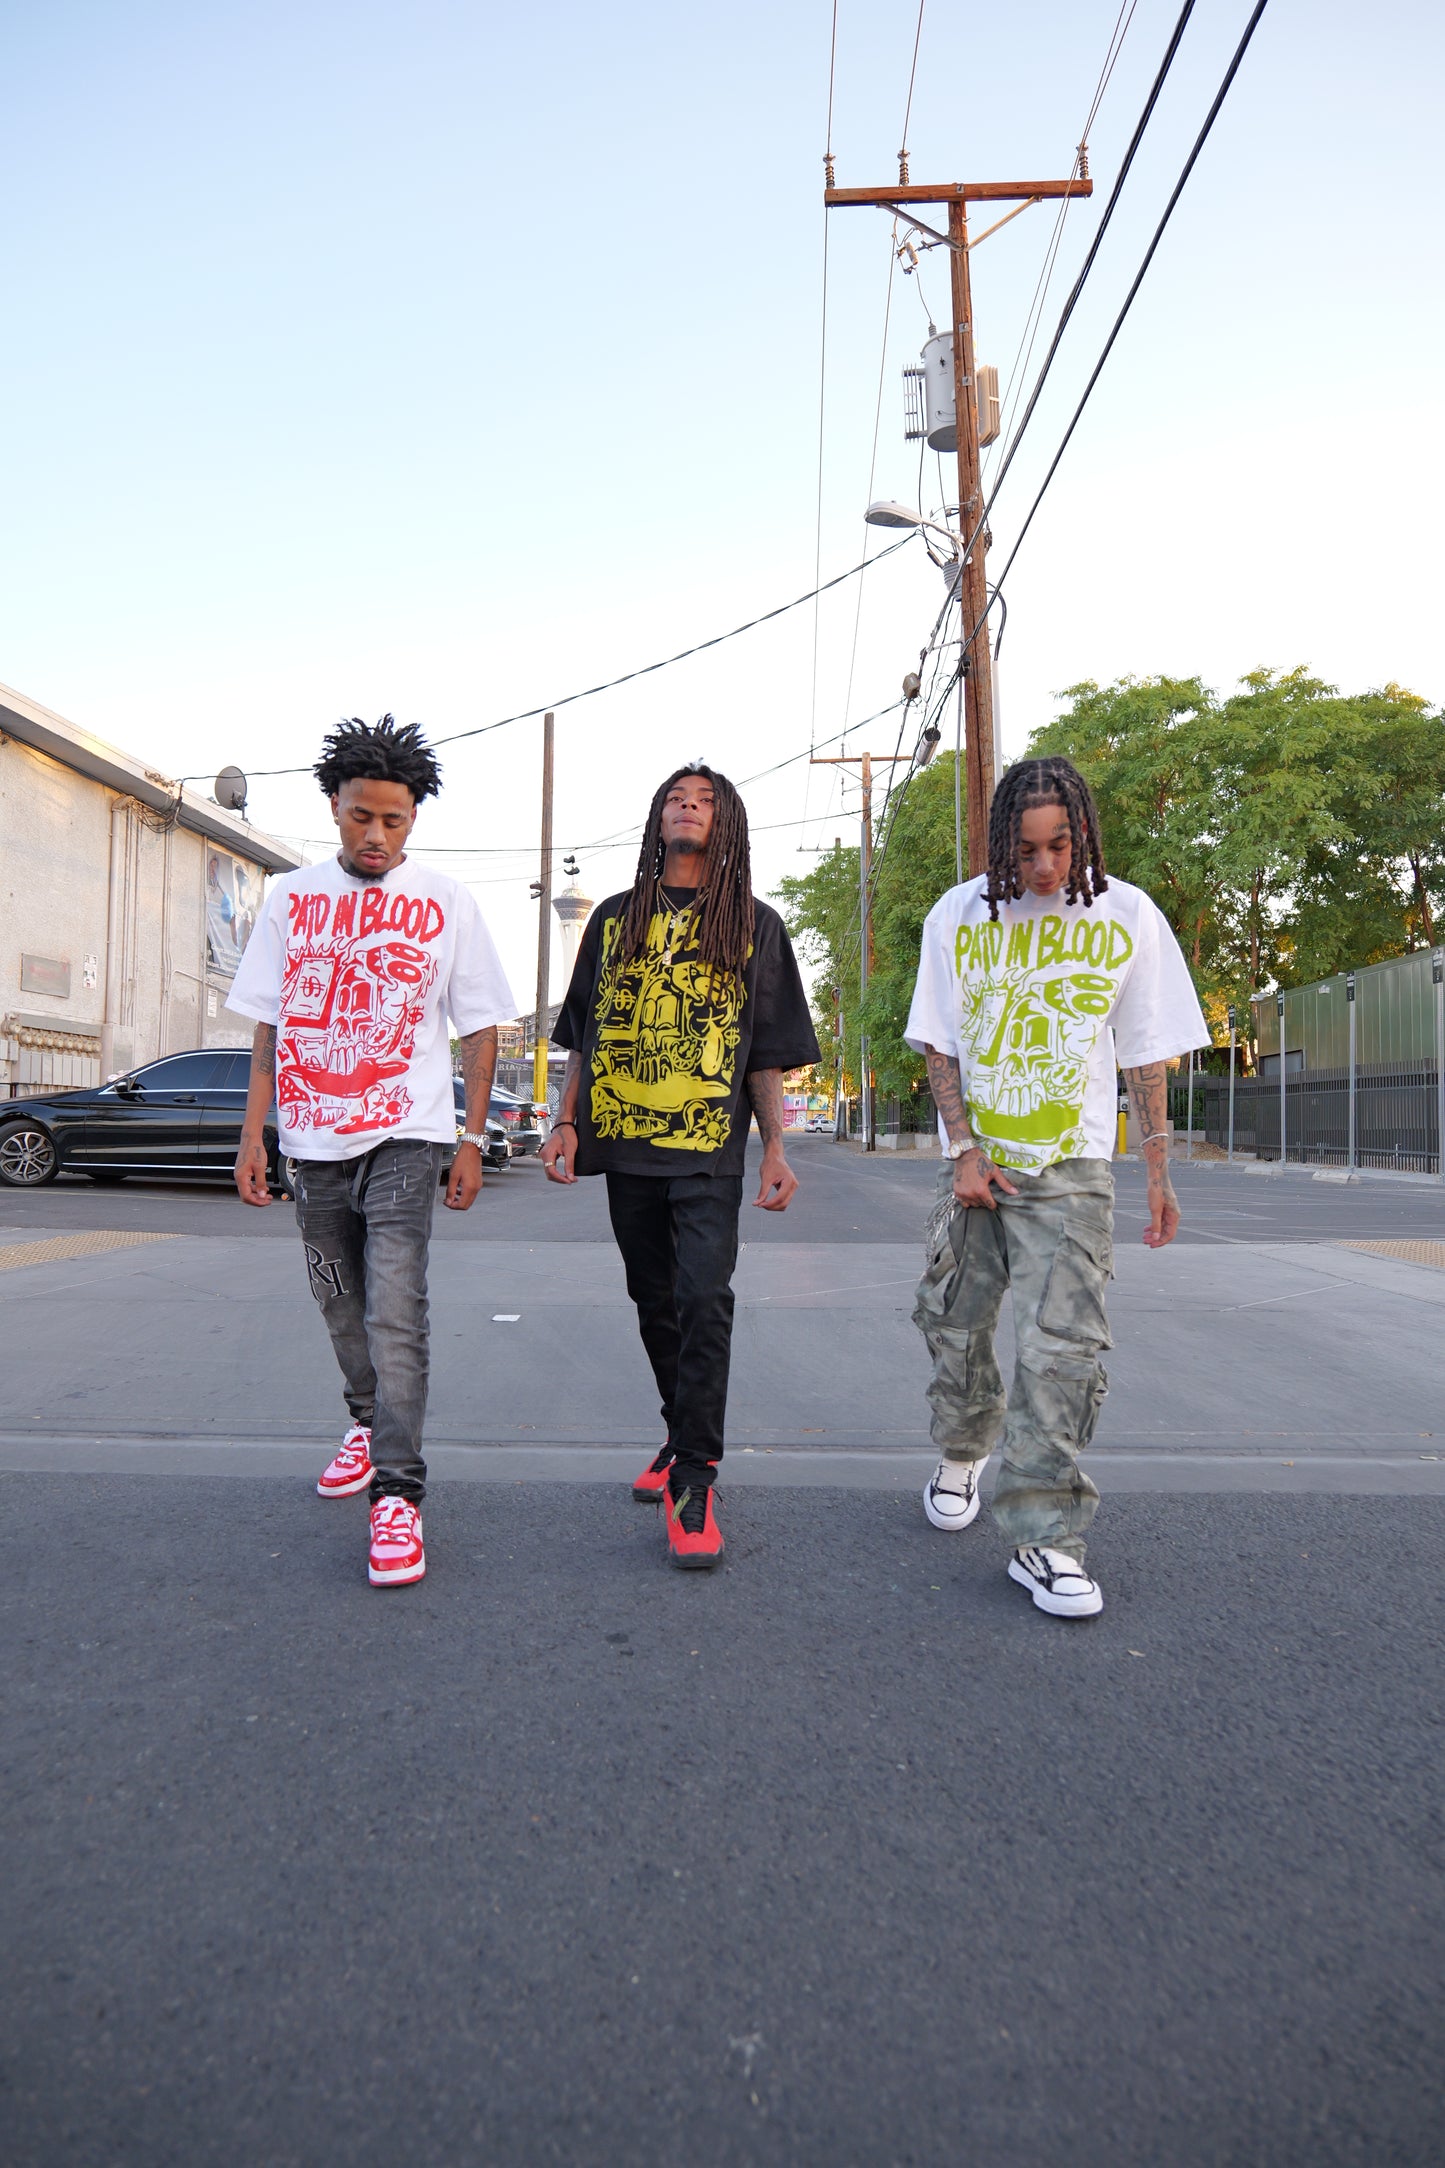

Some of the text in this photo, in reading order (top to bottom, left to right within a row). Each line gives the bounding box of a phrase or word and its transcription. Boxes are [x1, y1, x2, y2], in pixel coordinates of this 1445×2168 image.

[288, 887, 445, 944] PAID IN BLOOD
[954, 915, 1133, 979] PAID IN BLOOD
